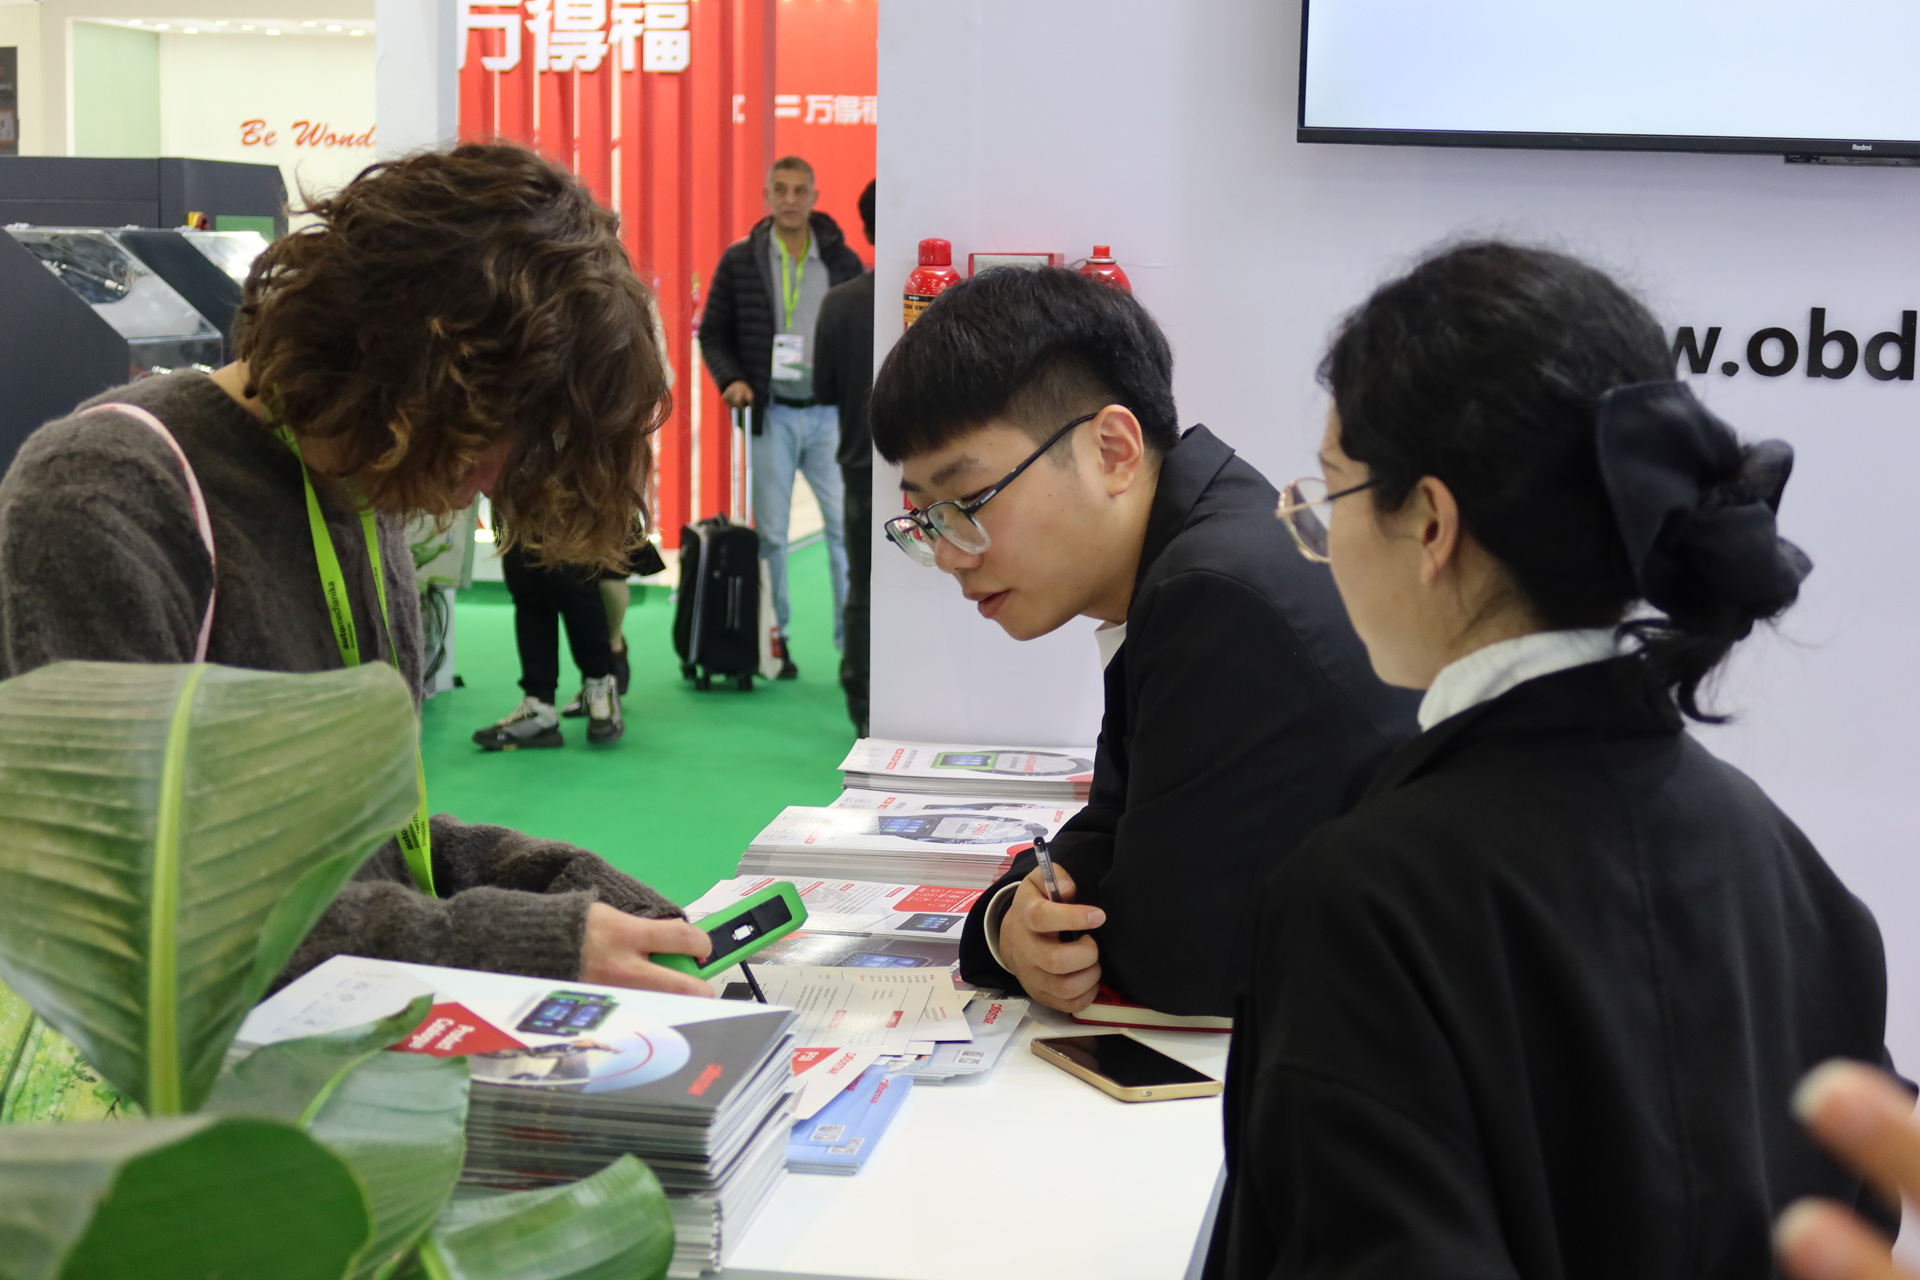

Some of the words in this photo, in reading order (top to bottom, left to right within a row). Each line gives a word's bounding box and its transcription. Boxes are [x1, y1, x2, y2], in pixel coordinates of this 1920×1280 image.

[240, 119, 277, 146] Be
[291, 119, 376, 148] Wond
[1852, 143, 1872, 151] Redmi
[328, 581, 349, 650] automechanika
[434, 1023, 476, 1052] Product
